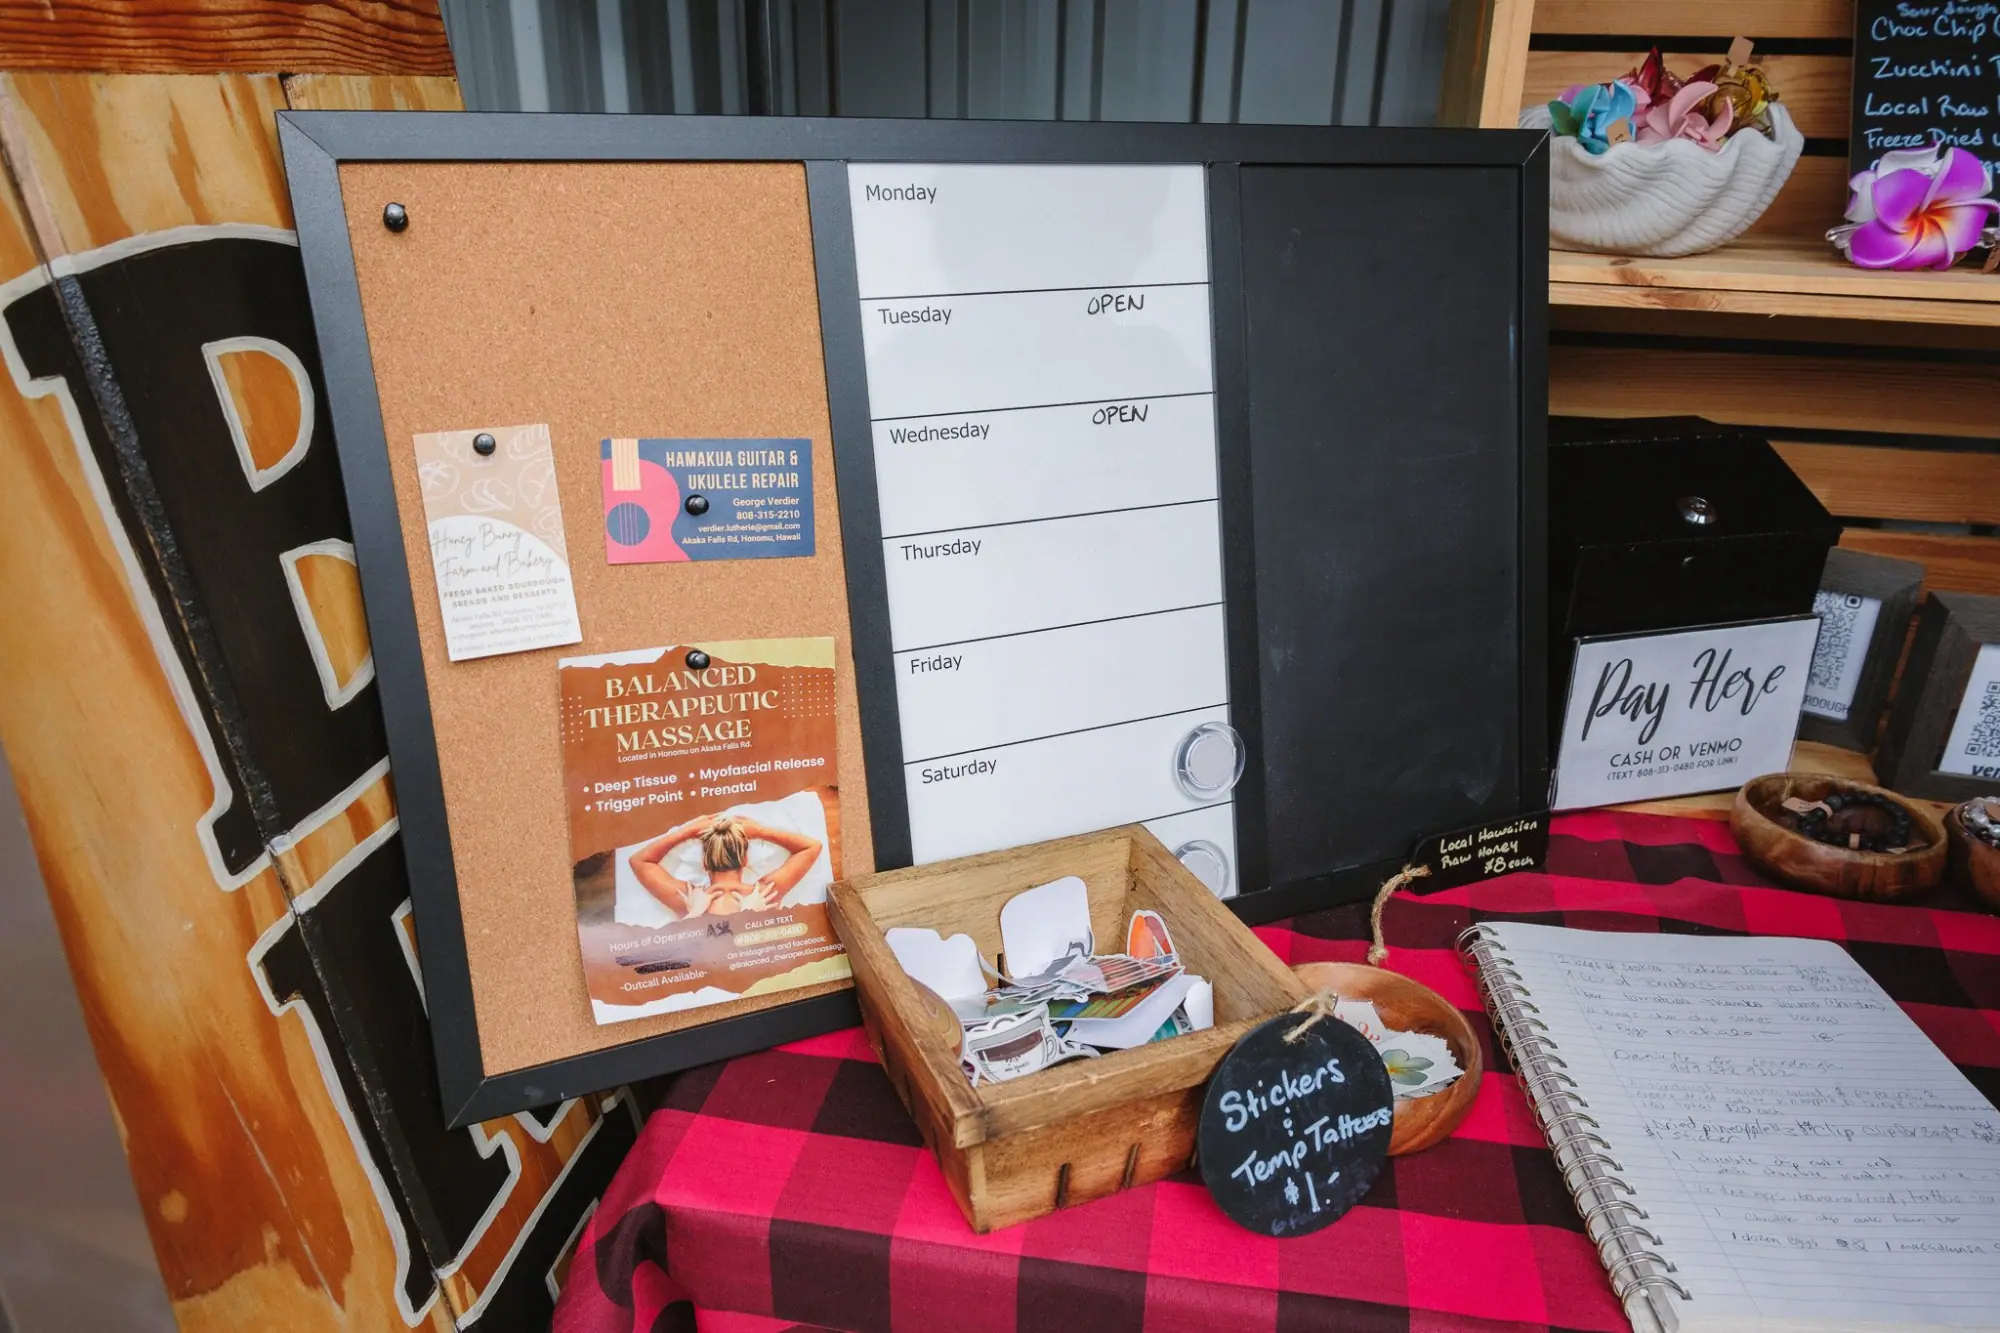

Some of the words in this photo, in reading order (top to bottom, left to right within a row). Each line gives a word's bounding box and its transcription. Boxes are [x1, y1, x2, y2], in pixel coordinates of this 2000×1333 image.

[1871, 16, 1928, 41] Choc
[1933, 15, 1987, 43] Chip
[1871, 55, 1982, 79] Zucchini
[1864, 92, 1928, 116] Local
[1936, 94, 1989, 117] Raw
[1863, 127, 1925, 149] Freeze
[1926, 126, 1984, 147] Dried
[865, 184, 937, 204] Monday
[878, 307, 952, 325] Tuesday
[1087, 294, 1145, 316] OPEN
[1092, 404, 1149, 426] OPEN
[890, 423, 990, 445] Wednesday
[666, 450, 734, 467] HAMAKUA
[738, 450, 785, 466] GUITAR
[789, 450, 799, 466] &
[688, 473, 748, 490] UKULELE
[751, 472, 799, 489] REPAIR
[732, 497, 765, 508] George
[767, 496, 800, 506] Verdier
[736, 510, 800, 520] 808-315-2210
[900, 537, 982, 562] Thursday
[910, 653, 963, 675] Friday
[605, 666, 756, 699] BALANCED
[1581, 657, 1669, 746] Pay
[1689, 647, 1787, 717] Here
[584, 689, 779, 728] THERAPEUTIC
[617, 720, 752, 753] MASSAGE
[618, 753, 649, 763] Located
[1610, 749, 1654, 767] CASH
[1659, 746, 1681, 761] OR
[1689, 738, 1742, 757] VENMO
[1697, 760, 1714, 768] FOR
[700, 763, 771, 781] Myofascial
[774, 756, 825, 771] Release
[922, 758, 997, 785] Saturday
[594, 779, 630, 794] Deep
[633, 773, 677, 788] Tissue
[701, 781, 757, 797] Prenatal
[596, 797, 646, 813] Trigger
[649, 790, 683, 805] Point
[1440, 834, 1472, 854] Local
[1441, 854, 1471, 870] Raw
[1478, 840, 1518, 858] Honey
[745, 920, 763, 930] CALL
[776, 915, 793, 924] TEXT
[610, 940, 639, 952] Hours
[641, 938, 651, 947] of
[653, 929, 704, 945] Operation:
[1219, 1058, 1345, 1132] Stickers
[1231, 1140, 1307, 1187] Temp
